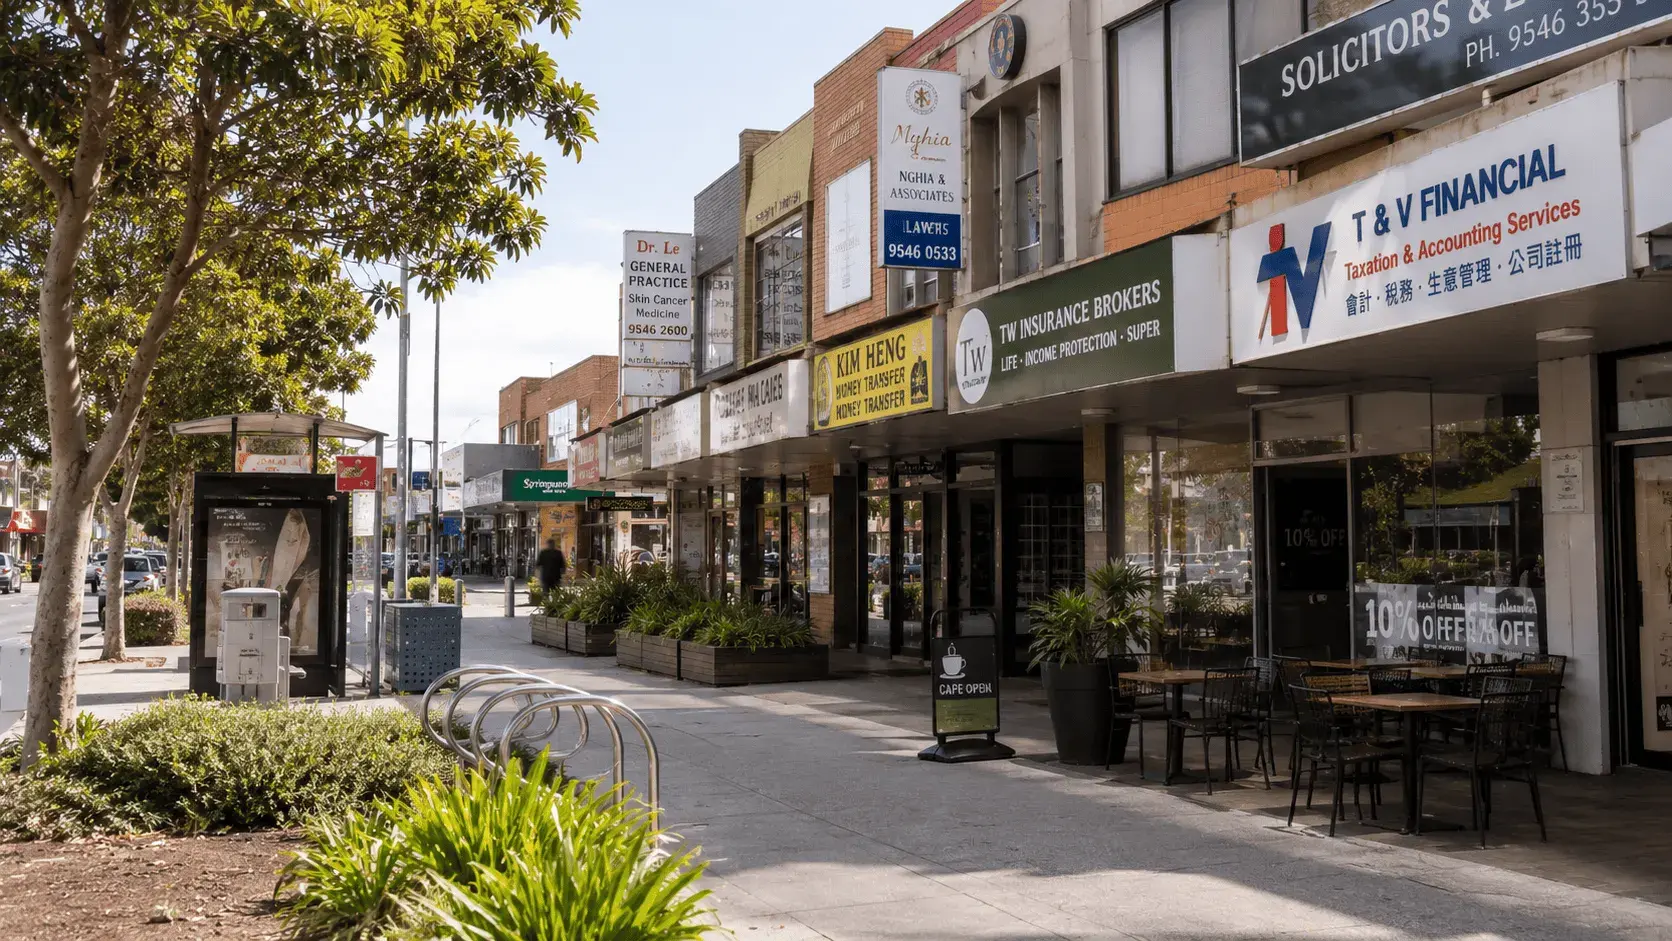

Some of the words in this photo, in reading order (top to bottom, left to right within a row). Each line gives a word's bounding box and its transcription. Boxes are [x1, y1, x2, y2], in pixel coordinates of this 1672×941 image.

[1281, 0, 1450, 98] SOLICITORS
[1466, 34, 1500, 68] PH.
[1508, 8, 1566, 52] 9546
[899, 170, 934, 184] NGHIA
[938, 173, 946, 186] &
[1352, 209, 1367, 243] T
[1373, 203, 1391, 237] &
[1396, 193, 1413, 229] V
[1420, 143, 1566, 222] FINANCIAL
[636, 239, 658, 254] Dr.
[663, 240, 680, 255] Le
[888, 243, 921, 259] 9546
[925, 245, 957, 261] 0533
[1344, 252, 1399, 282] Taxation
[1403, 243, 1414, 265] &
[1418, 221, 1502, 261] Accounting
[1507, 198, 1581, 236] Services
[630, 260, 687, 274] GENERAL
[1427, 256, 1492, 297] 生意管理
[629, 275, 688, 289] PRACTICE
[628, 293, 650, 305] Skin
[653, 294, 688, 306] Cancer
[636, 308, 680, 319] Medicine
[1000, 320, 1017, 345] TW
[1020, 299, 1090, 340] INSURANCE
[1094, 278, 1161, 320] BROKERS
[628, 323, 657, 335] 9546
[660, 324, 688, 336] 2600
[836, 347, 861, 379] KIM
[866, 333, 907, 371] HENG
[1001, 353, 1018, 372] LIFE
[1025, 344, 1057, 367] INCOME
[1059, 329, 1117, 359] PROTECTION
[1127, 319, 1161, 343] SUPER
[1365, 598, 1420, 643] 10%
[1500, 619, 1535, 647] OFF
[939, 683, 964, 696] CAFE
[965, 682, 993, 695] OPEN
